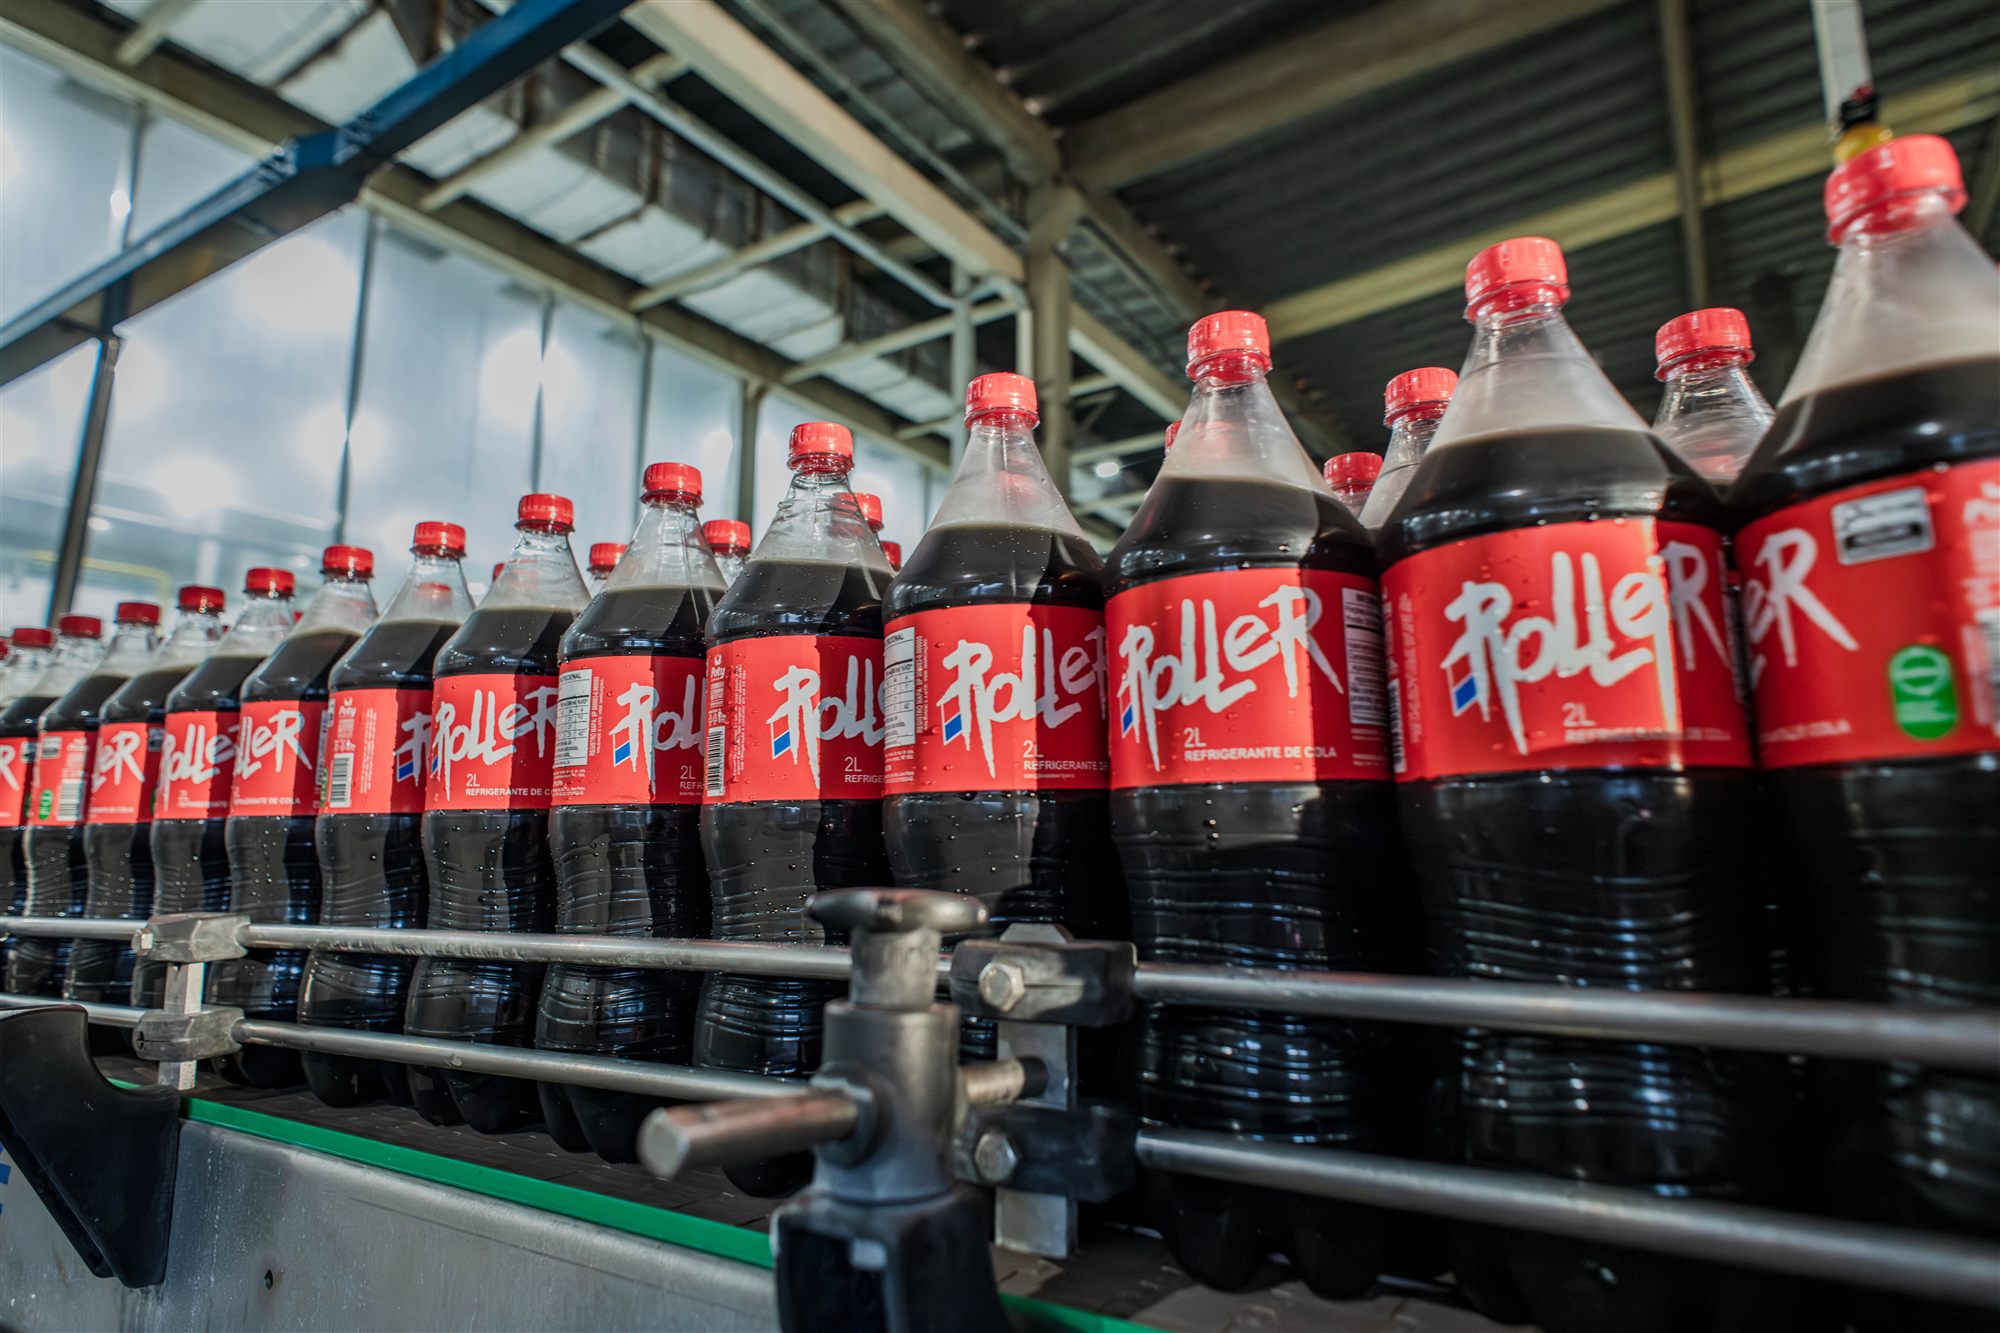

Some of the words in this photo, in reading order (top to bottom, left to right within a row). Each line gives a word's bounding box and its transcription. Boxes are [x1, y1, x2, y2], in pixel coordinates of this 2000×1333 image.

[1562, 702, 1597, 727] 2L
[1184, 727, 1206, 748] 2L
[1023, 739, 1045, 758] 2L
[1184, 748, 1281, 761] REFRIGERANTE
[1284, 747, 1301, 758] DE
[1304, 747, 1337, 758] COLA
[844, 756, 862, 772] 2L
[1023, 760, 1098, 771] REFRIGERANTE
[465, 773, 480, 787] 2L
[680, 765, 696, 780] 2L
[465, 788, 528, 796] REFRIGERANTE
[530, 788, 542, 796] DE
